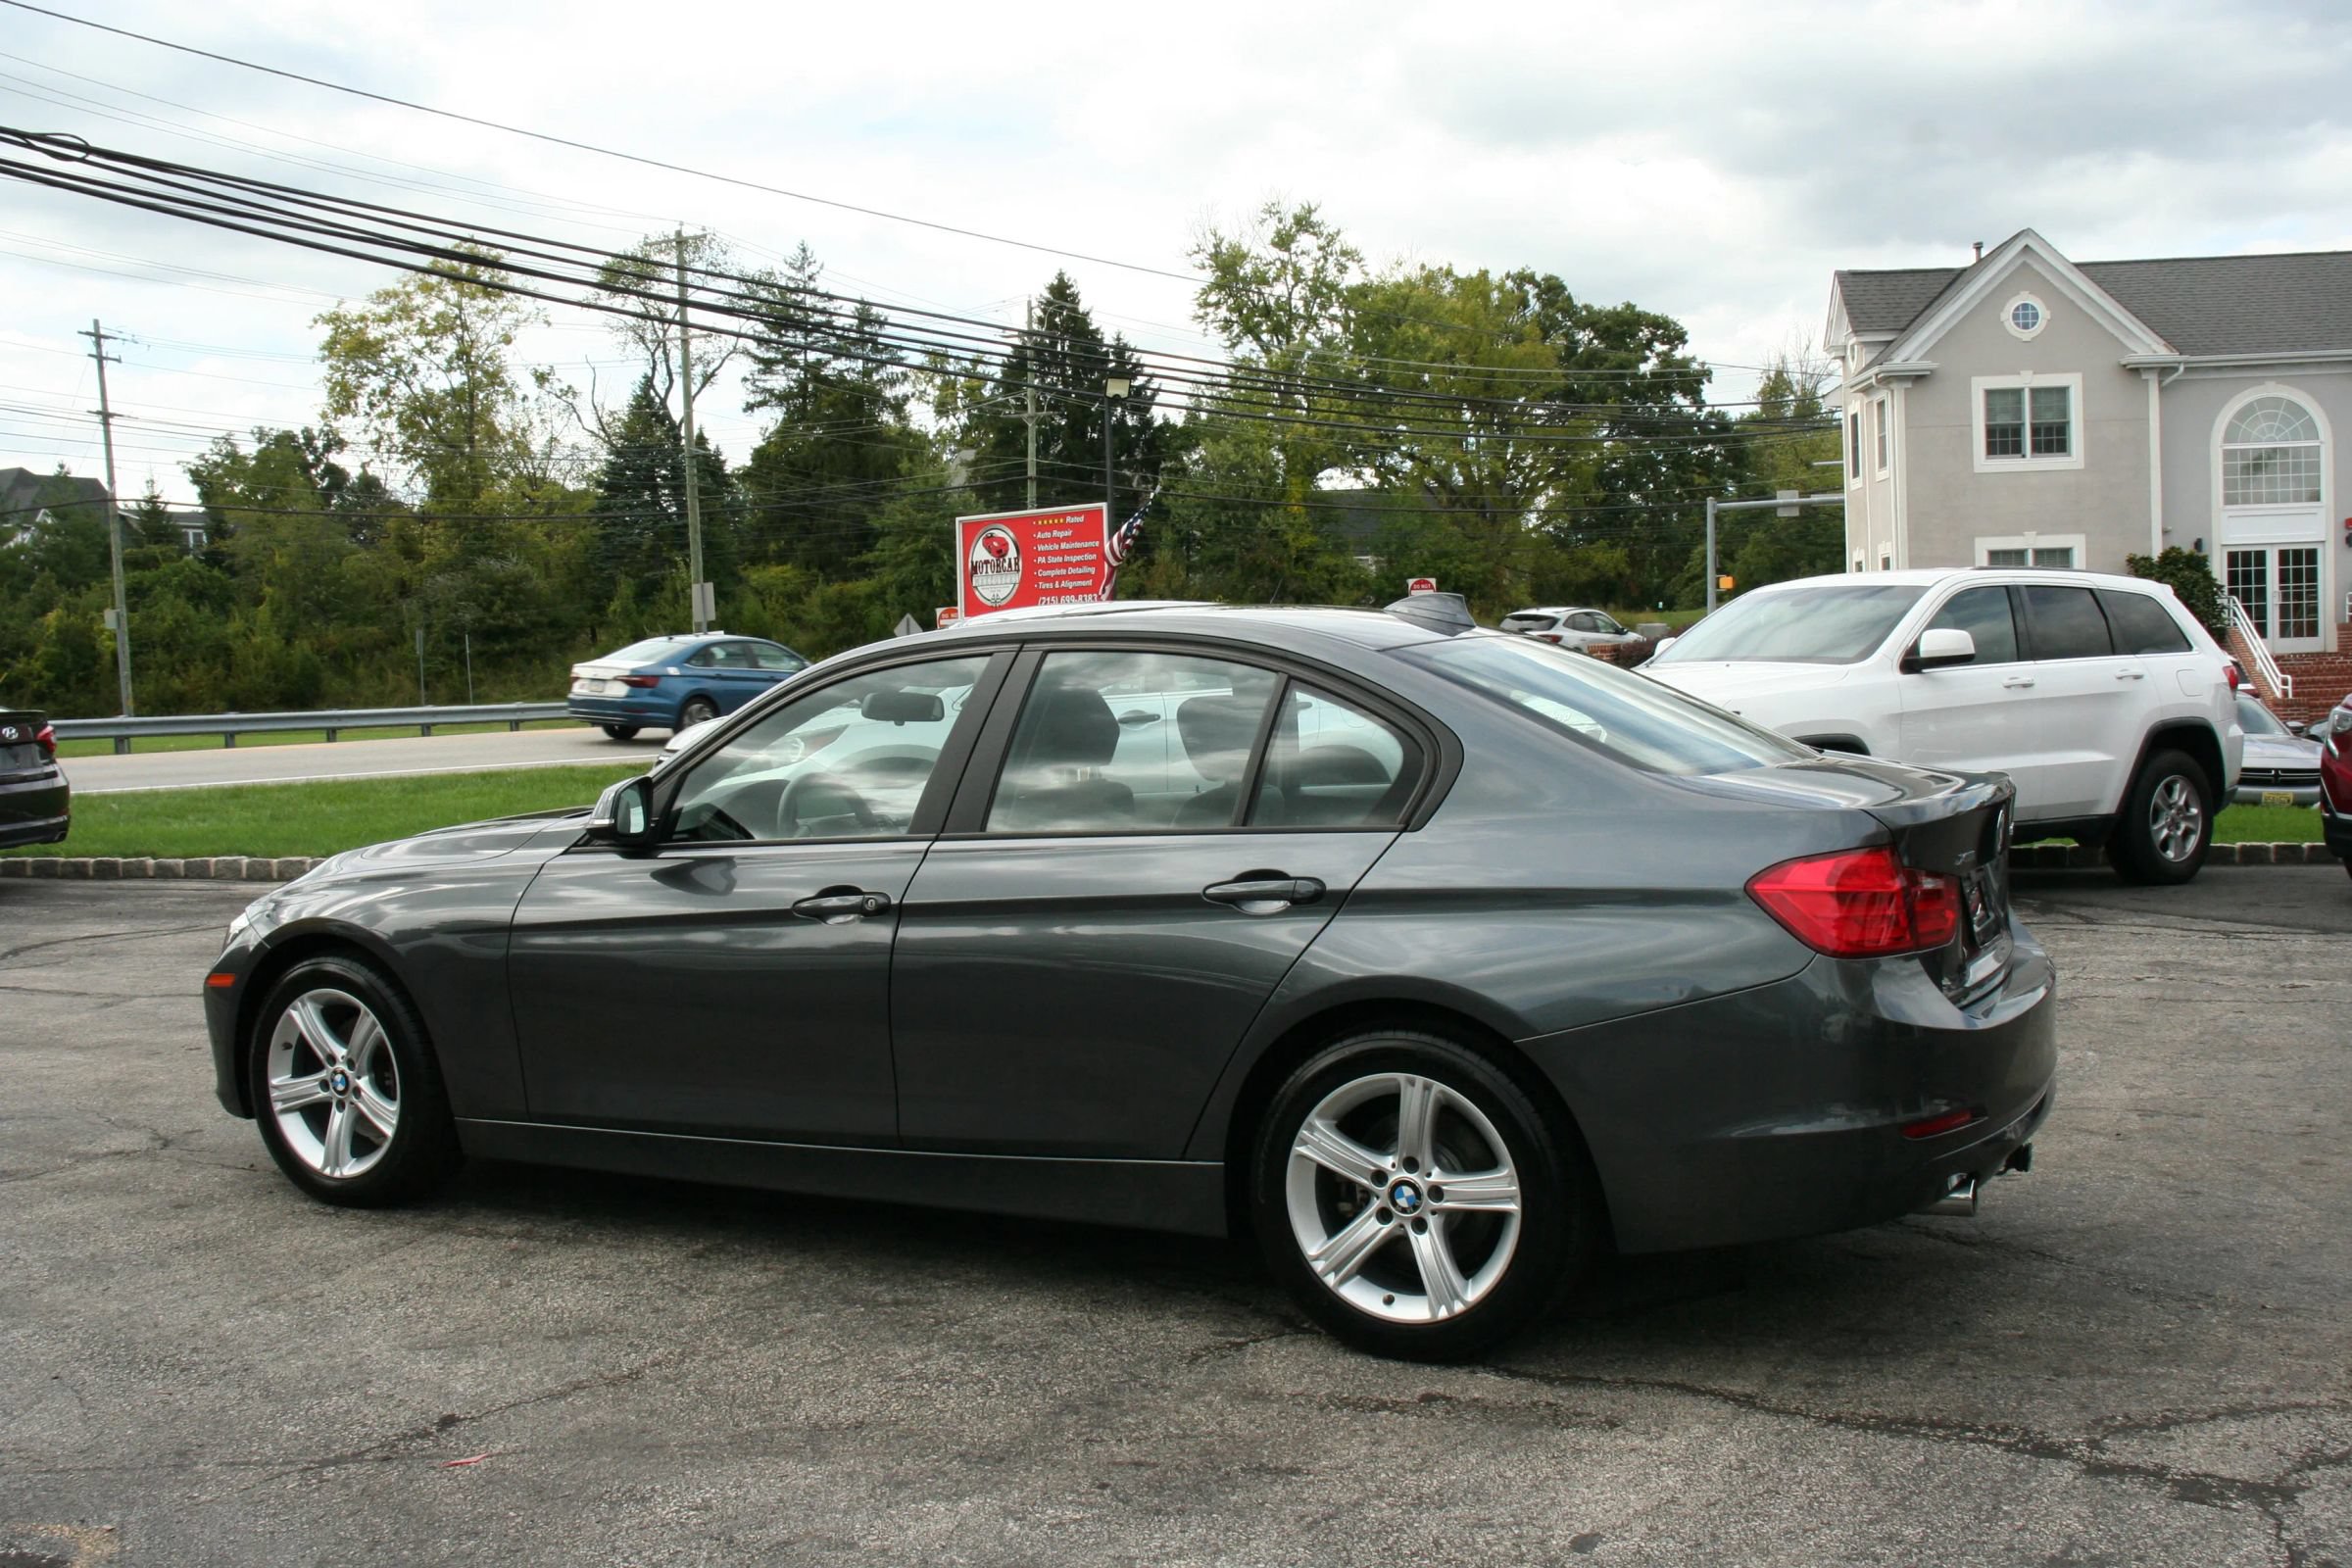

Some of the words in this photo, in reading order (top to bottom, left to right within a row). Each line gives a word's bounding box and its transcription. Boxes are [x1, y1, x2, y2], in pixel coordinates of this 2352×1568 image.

[1065, 514, 1085, 523] Rated
[1052, 528, 1073, 539] Repair
[1037, 543, 1059, 552] Vehicle
[1059, 540, 1100, 550] Maintenance
[1037, 556, 1047, 564] PA
[1047, 555, 1063, 564] State
[1063, 552, 1097, 564] Inspection
[970, 557, 1020, 575] MOTORCAR
[1038, 567, 1067, 578] Complete
[1067, 565, 1096, 575] Detailing
[1060, 578, 1093, 589] Alignment
[1038, 595, 1058, 606] (215)
